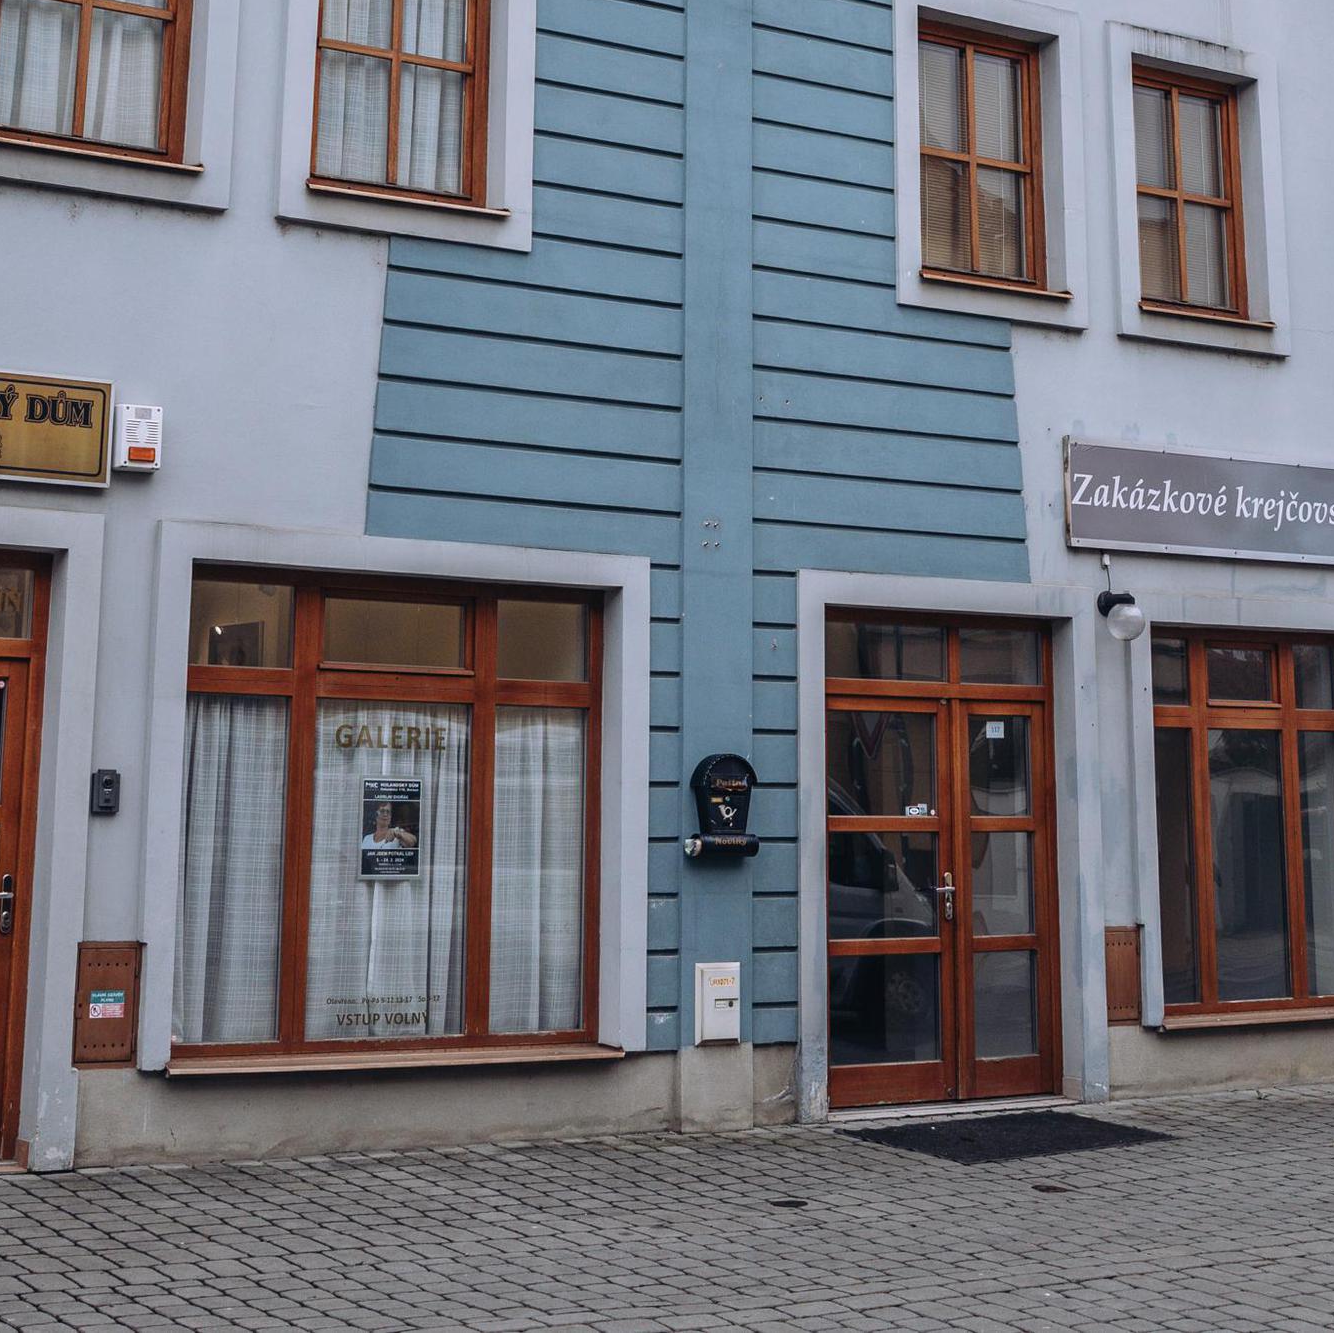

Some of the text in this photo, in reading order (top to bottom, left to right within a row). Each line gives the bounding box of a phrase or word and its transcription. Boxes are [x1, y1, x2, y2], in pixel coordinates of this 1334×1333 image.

[24, 390, 95, 428] DŮM
[1071, 473, 1227, 517] Zakázkové
[335, 724, 447, 751] GALERIE
[336, 1012, 380, 1026] VSTUP
